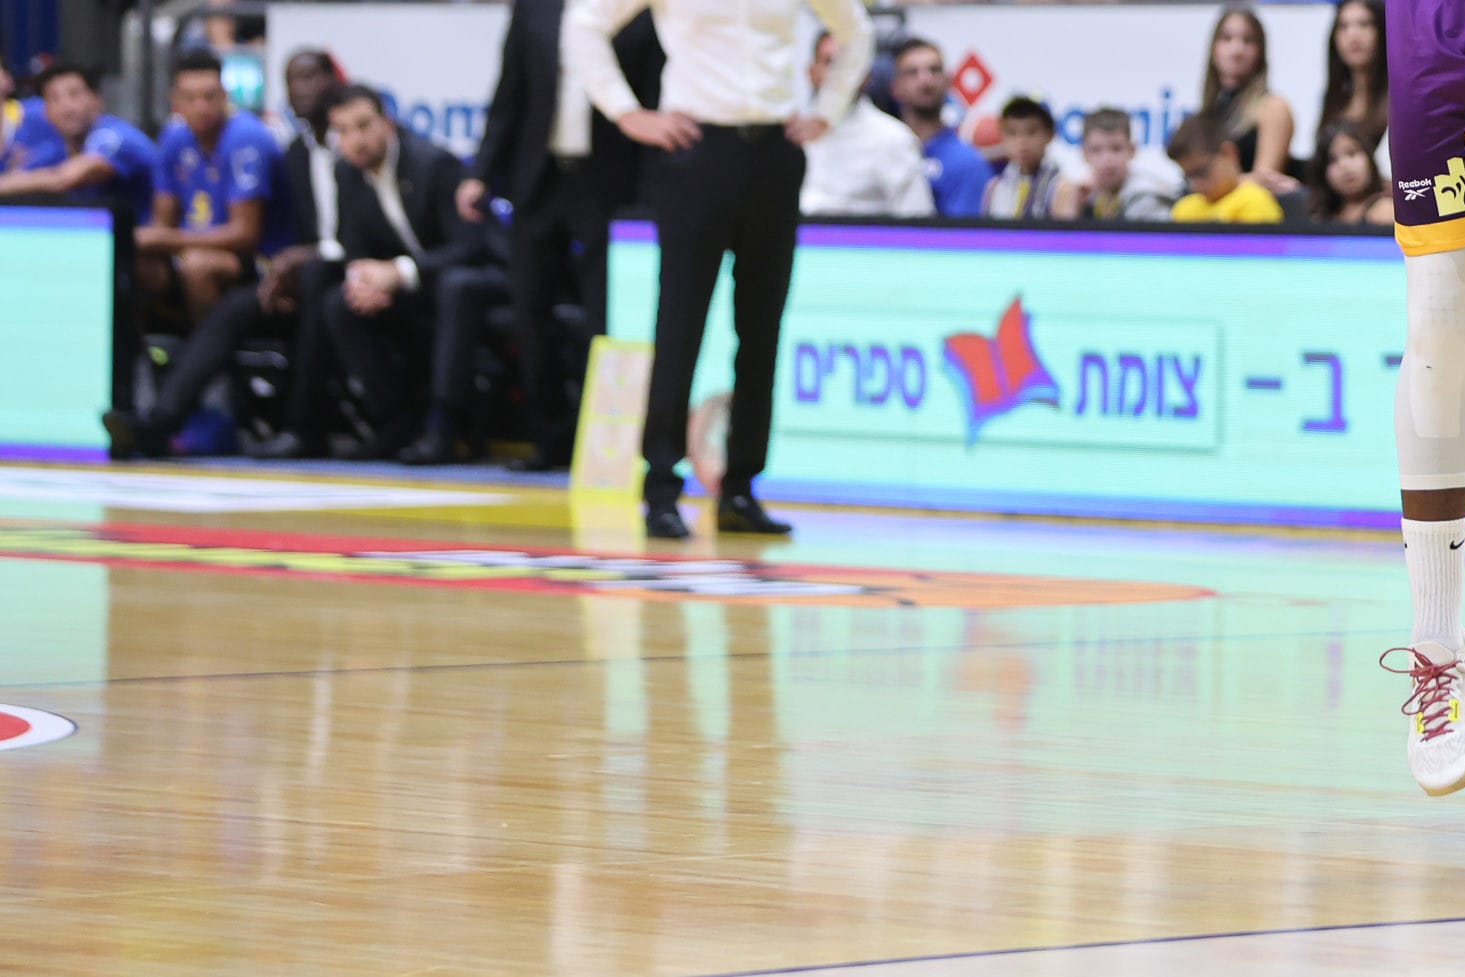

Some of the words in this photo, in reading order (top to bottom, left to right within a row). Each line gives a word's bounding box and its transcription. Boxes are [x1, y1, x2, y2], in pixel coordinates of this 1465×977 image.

[1398, 178, 1432, 190] Reebok
[794, 342, 927, 409] ספרים
[1074, 351, 1201, 418] צומת
